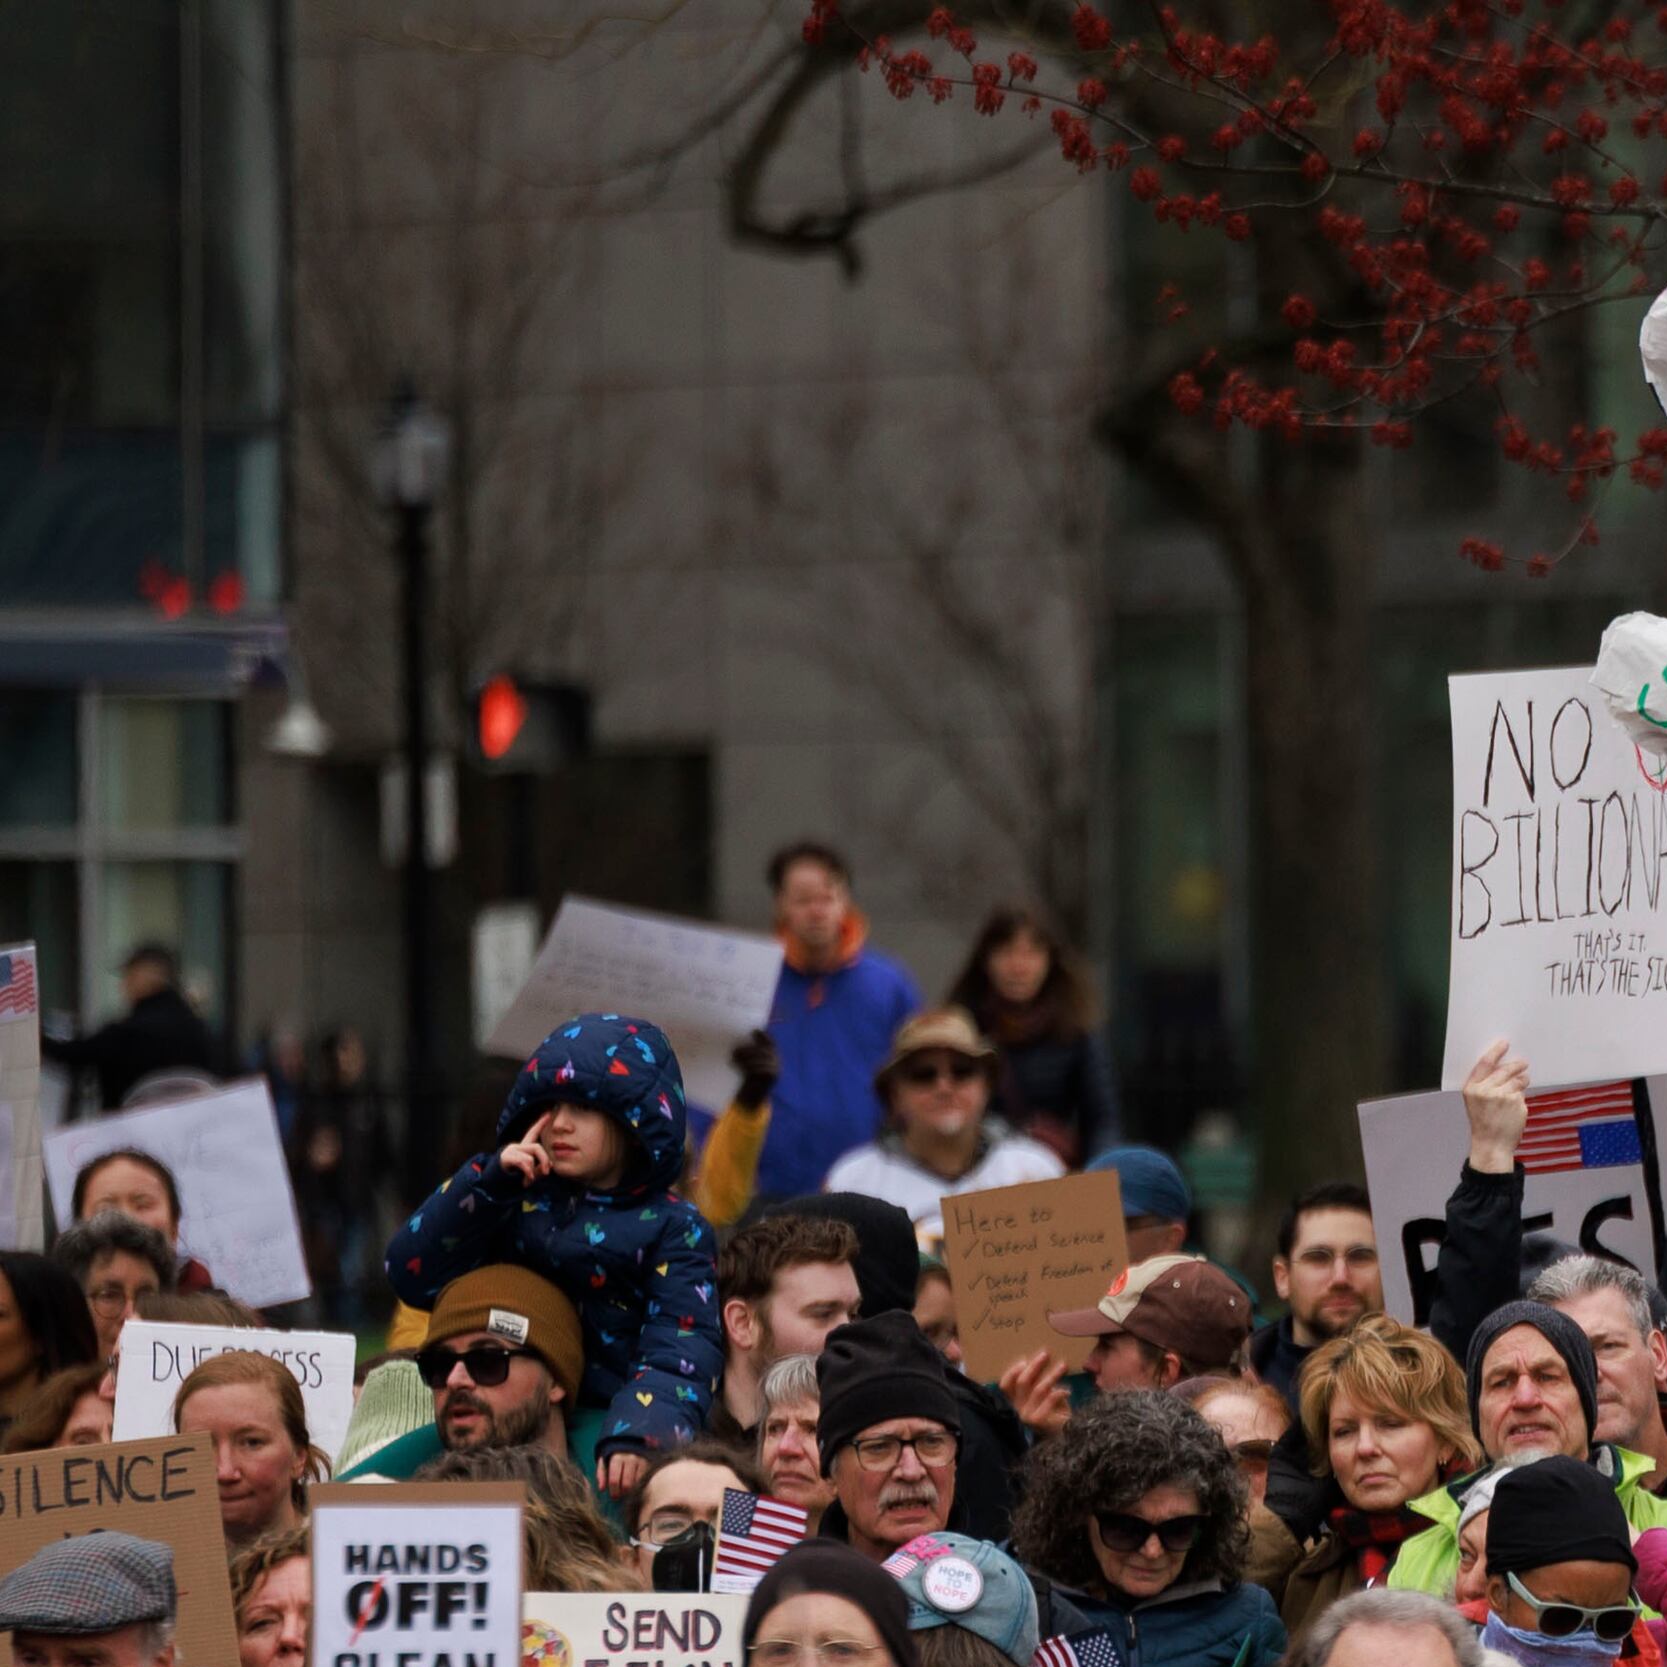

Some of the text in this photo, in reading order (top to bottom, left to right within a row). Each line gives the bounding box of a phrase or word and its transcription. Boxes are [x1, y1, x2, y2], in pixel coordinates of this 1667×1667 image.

[1482, 697, 1593, 807] NO
[1573, 928, 1622, 958] THAT'S
[1609, 957, 1640, 998] THE
[954, 1207, 1052, 1235] Here to
[345, 1544, 488, 1574] HANDS
[939, 1566, 973, 1581] HOPE
[346, 1580, 490, 1632] OFF!
[933, 1584, 967, 1600] NOPE
[603, 1602, 722, 1652] SEND
